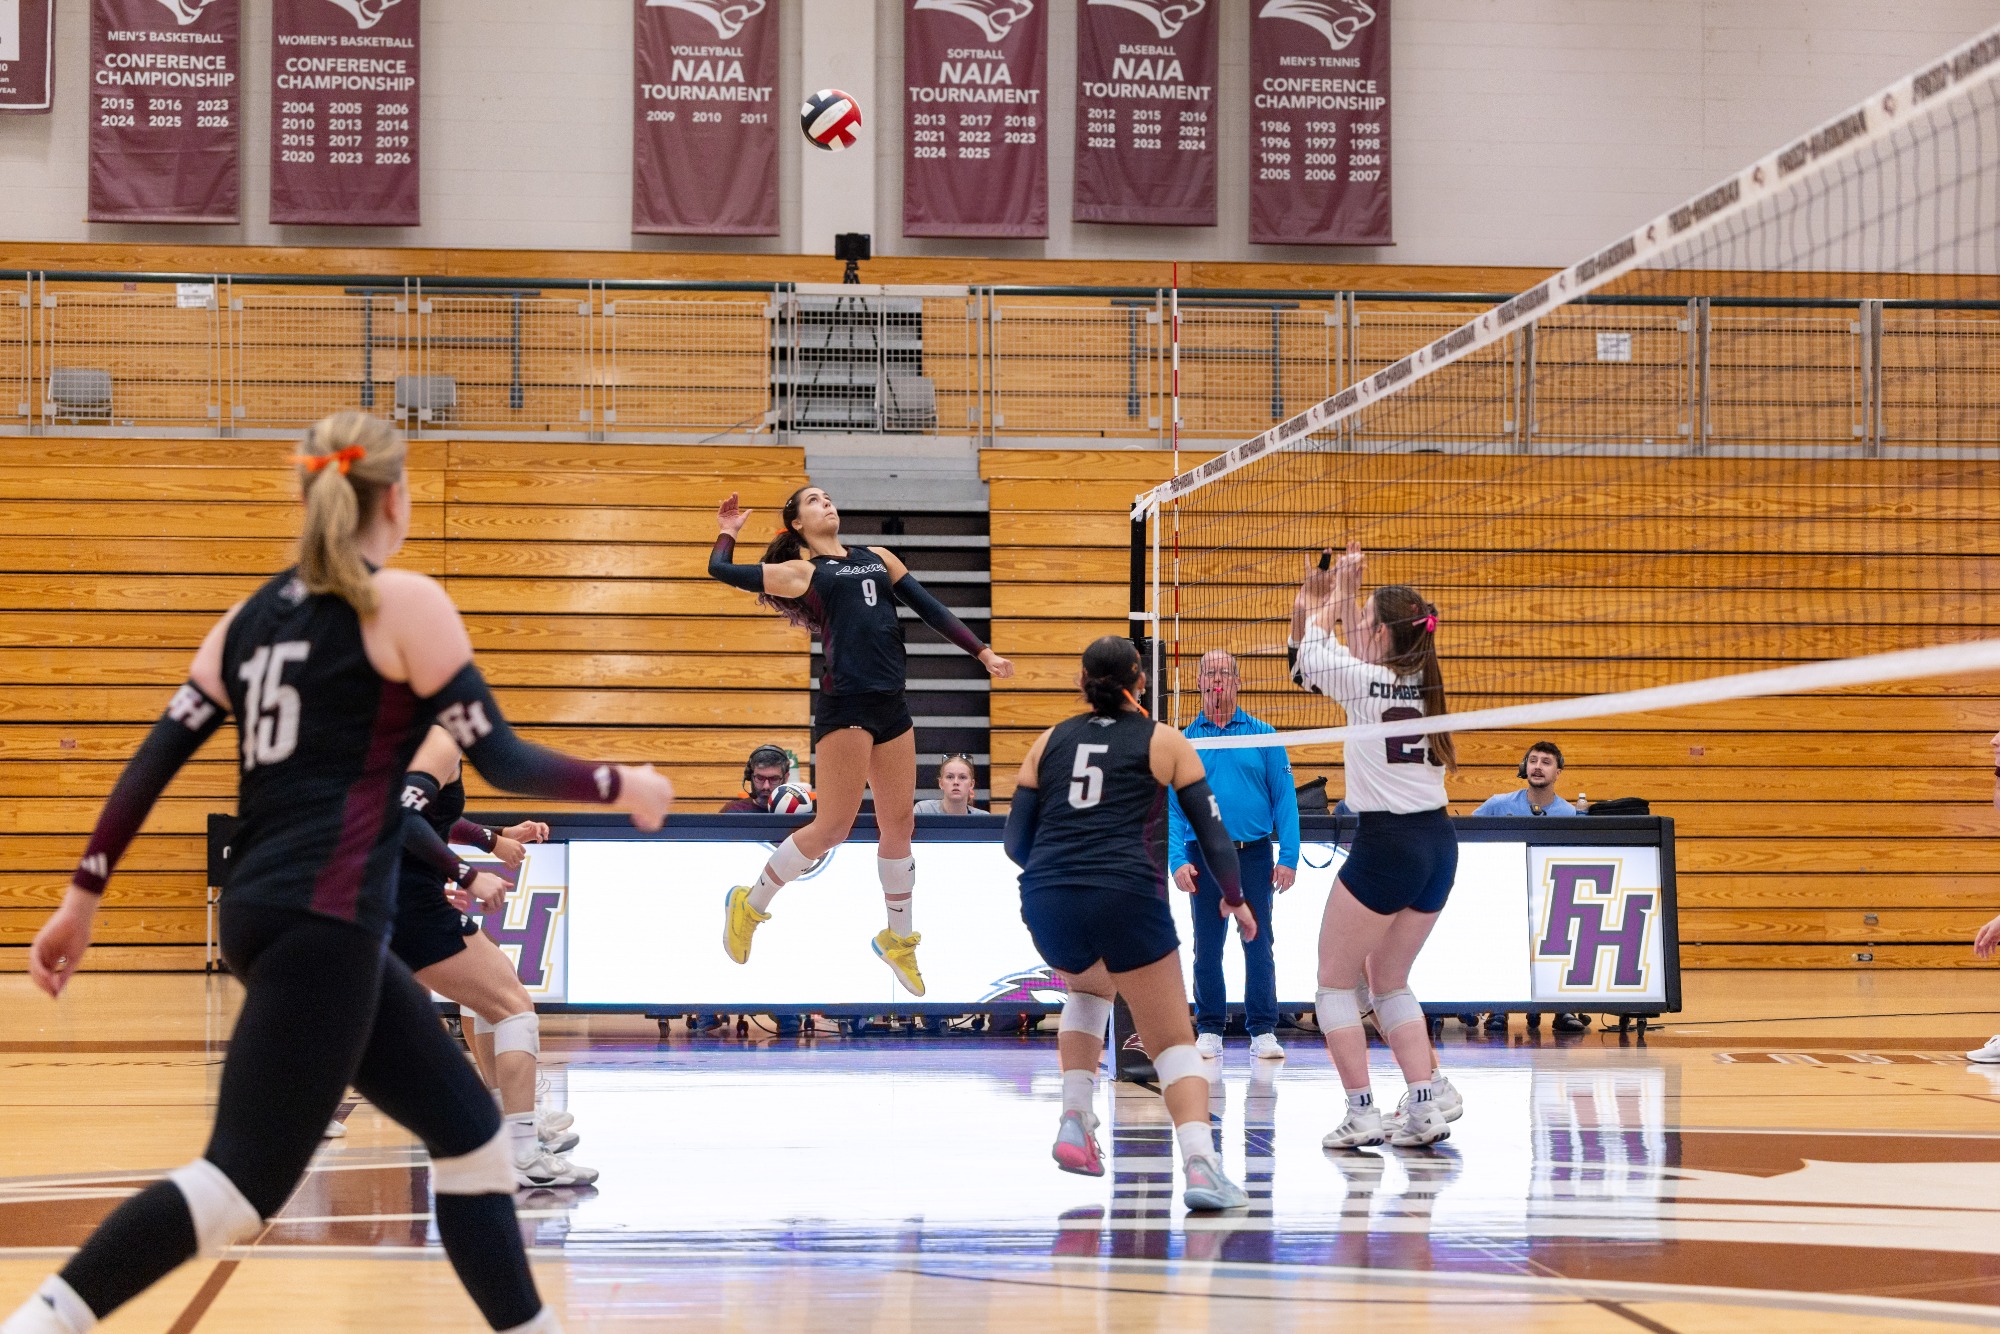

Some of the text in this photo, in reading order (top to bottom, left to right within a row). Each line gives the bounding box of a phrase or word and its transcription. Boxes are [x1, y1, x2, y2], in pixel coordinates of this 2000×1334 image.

[150, 32, 224, 44] BASKETBALL
[341, 36, 415, 48] BASKETBALL
[671, 46, 744, 57] VOLLEYBALL
[948, 49, 1006, 60] SOFTBALL
[1120, 45, 1177, 56] BASEBALL
[105, 54, 226, 70] CONFERENCE
[286, 58, 407, 74] CONFERENCE
[1319, 57, 1361, 68] TENNIS
[672, 60, 745, 83] NAIA
[940, 62, 1012, 85] NAIA
[1113, 58, 1184, 82] NAIA
[96, 70, 235, 88] CHAMPIONSHIP
[277, 75, 415, 91] CHAMPIONSHIP
[1263, 78, 1377, 94] CONFERENCE
[641, 85, 773, 102] TOURNAMENT
[910, 87, 1040, 104] TOURNAMENT
[1083, 82, 1212, 101] TOURNAMENT
[101, 98, 229, 112] 2015 2016 2023
[283, 102, 409, 116] 2004 2005 2006
[1255, 95, 1386, 111] CHAMPIONSHIP
[101, 115, 230, 128] 2024 2025 2026
[647, 111, 768, 124] 2009 2010 2011
[914, 114, 1037, 128] 2013 2017 2018
[1088, 108, 1208, 123] 2012 2015 2016
[282, 118, 409, 132] 2010 2013 2014
[1088, 122, 1206, 137] 2018 2019 2021
[1261, 121, 1381, 135] 1986 1993 1995
[282, 134, 409, 148] 2015 2017 2019
[915, 131, 1036, 144] 2021 2022 2023
[1088, 137, 1206, 151] 2022 2023 2024
[1261, 137, 1381, 150] 1996 1997 1998
[282, 150, 411, 165] 2020 2023 2026
[915, 147, 991, 159] 2024 2025
[1261, 153, 1381, 166] 1999 2000 2004
[1260, 168, 1381, 182] 2005 2006 2007
[861, 578, 878, 607] 9
[1369, 681, 1425, 700] CUMBE
[238, 641, 312, 772] 15
[1068, 743, 1109, 809] 5
[401, 785, 430, 811] FH
[1533, 858, 1662, 992] FH
